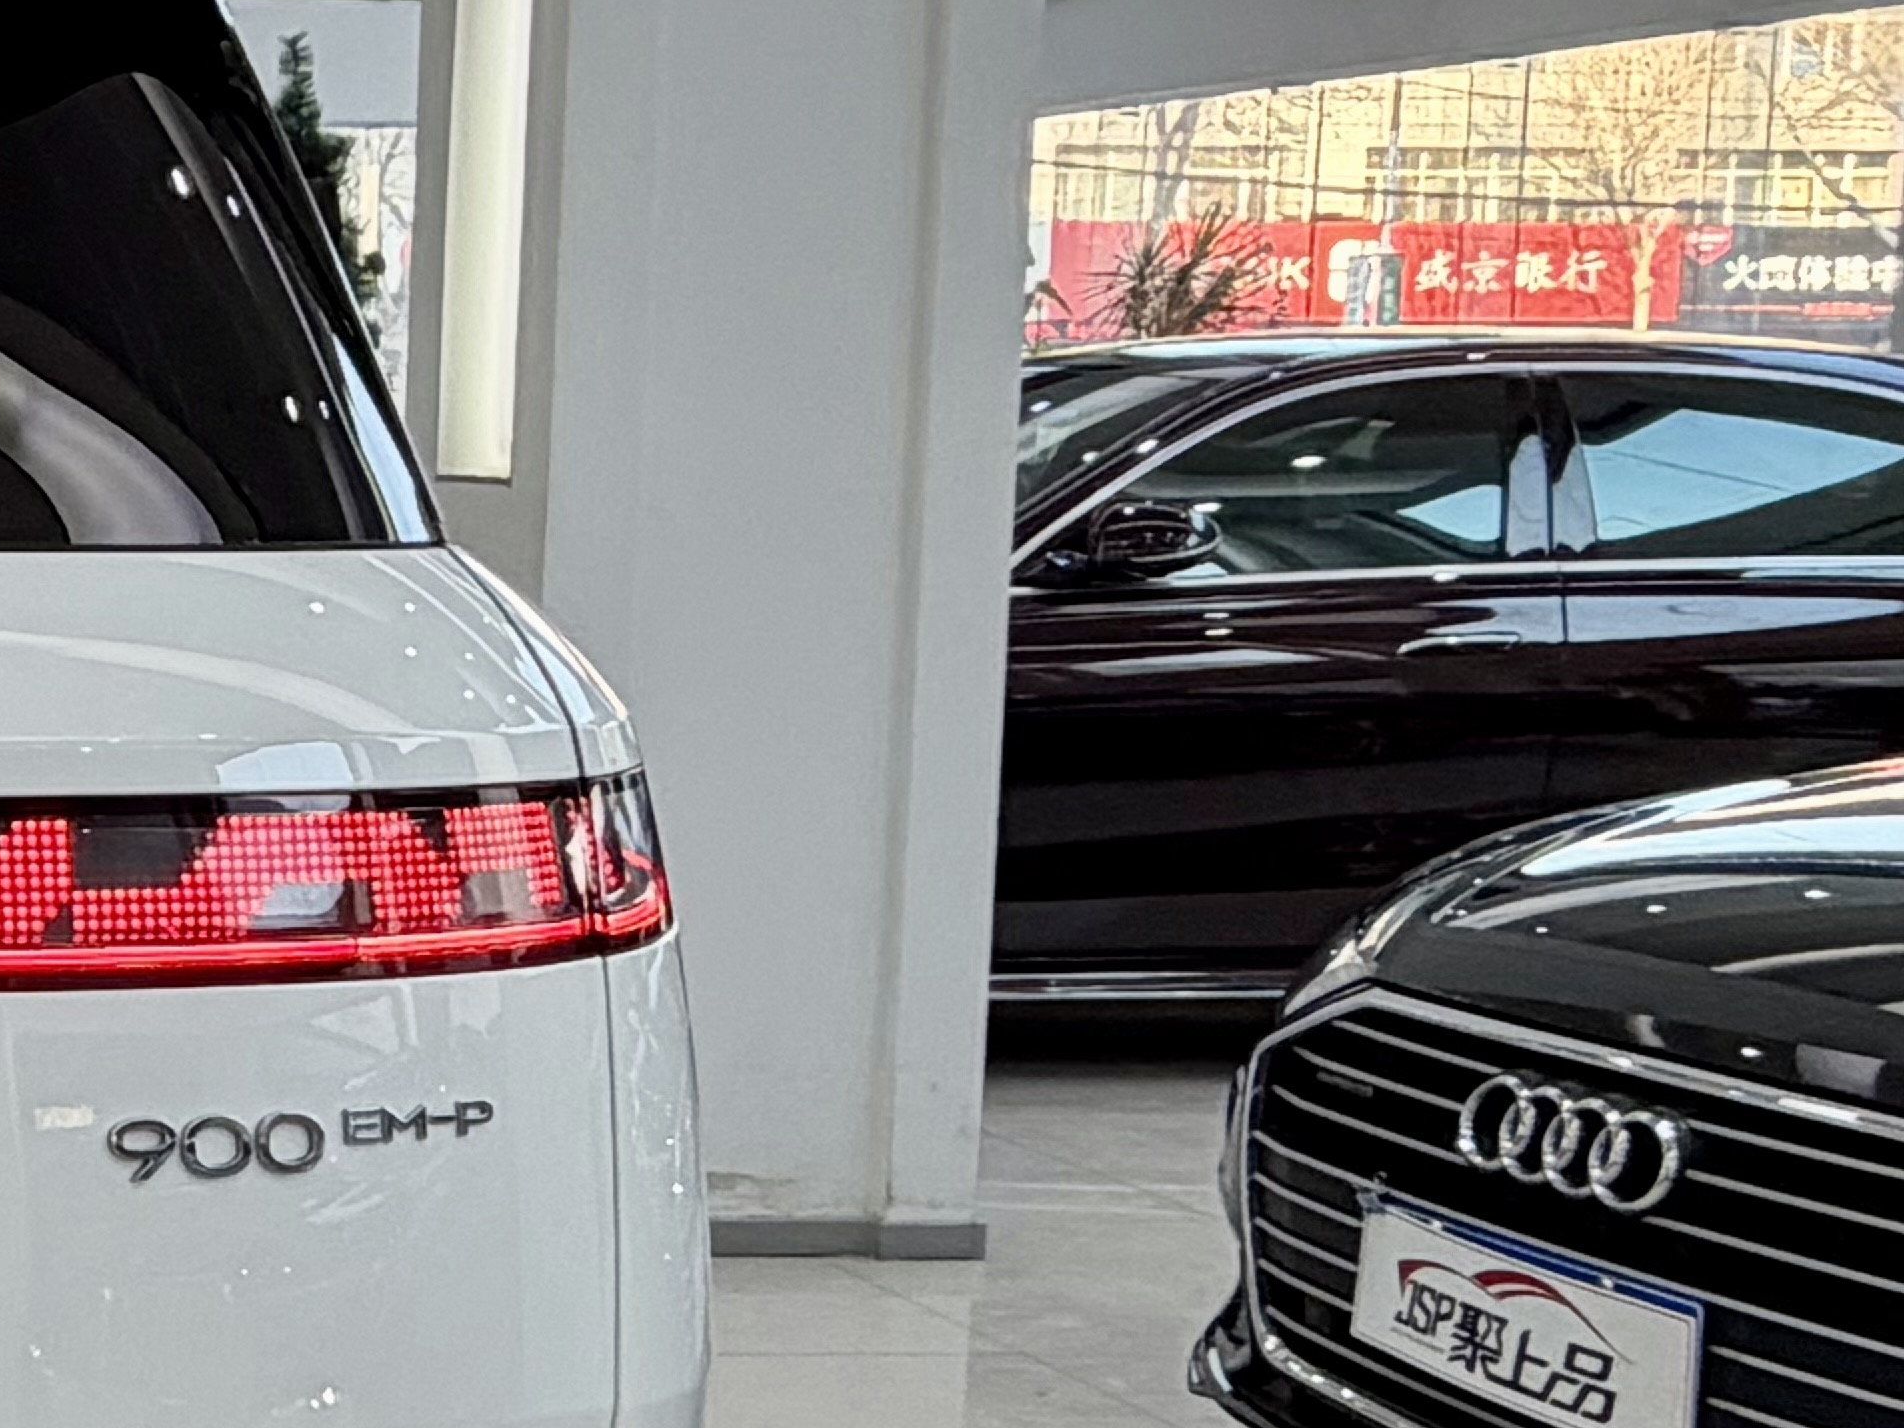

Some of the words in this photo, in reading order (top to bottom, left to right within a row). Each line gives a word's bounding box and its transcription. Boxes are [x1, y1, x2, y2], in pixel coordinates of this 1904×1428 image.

[1414, 249, 1607, 293] 盛京银行
[106, 1111, 325, 1183] 900
[341, 1100, 493, 1146] EM-P
